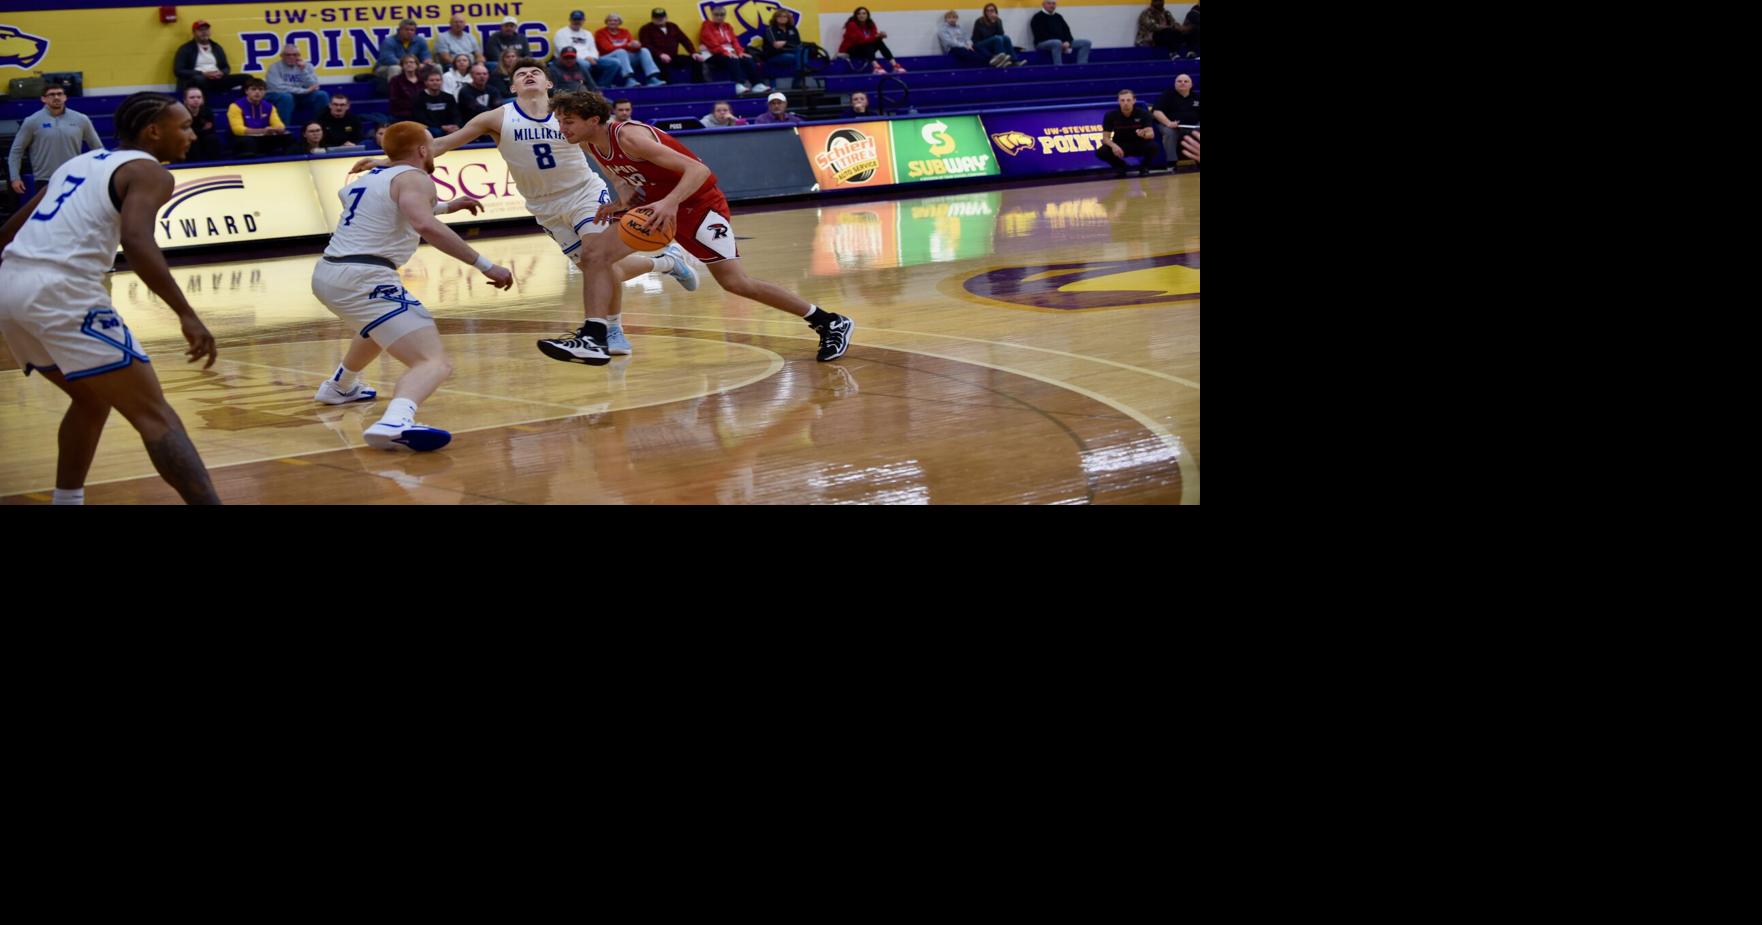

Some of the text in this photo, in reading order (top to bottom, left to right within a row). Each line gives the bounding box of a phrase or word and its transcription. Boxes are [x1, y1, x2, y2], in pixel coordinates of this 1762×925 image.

[265, 2, 523, 24] UW-STEVENS POINT
[238, 21, 551, 73] POINS
[1044, 124, 1104, 136] UW-STEVENS
[1038, 132, 1104, 154] POINT
[533, 143, 557, 170] 8
[908, 154, 990, 177] SUBWAY
[31, 174, 86, 222] 3
[344, 187, 367, 226] 7
[160, 214, 257, 239] YWARD
